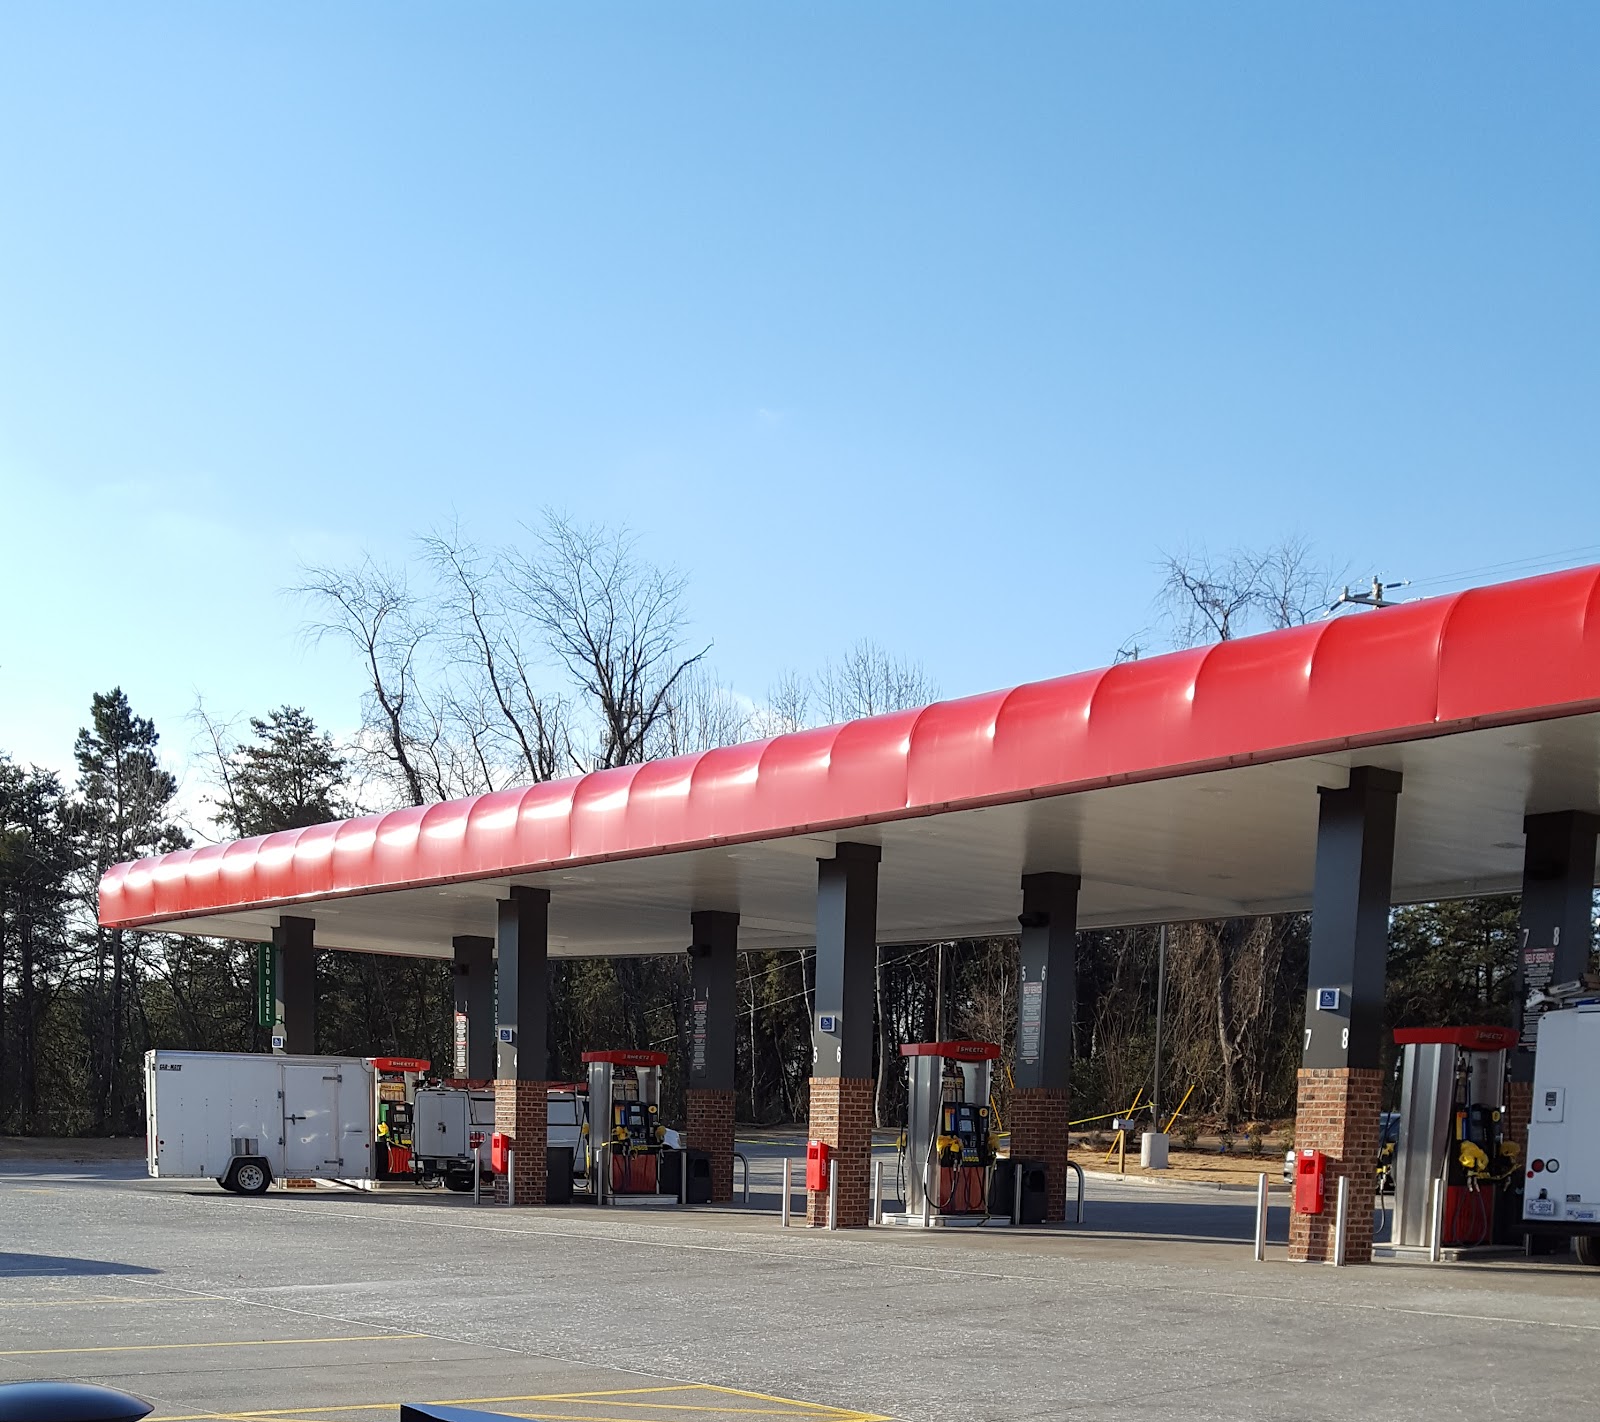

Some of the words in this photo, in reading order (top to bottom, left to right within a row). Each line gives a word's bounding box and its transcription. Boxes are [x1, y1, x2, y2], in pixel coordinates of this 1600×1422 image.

[1523, 929, 1530, 948] 7
[1553, 927, 1560, 946] 8
[1525, 954, 1535, 964] SELF
[1536, 952, 1554, 963] SERVICE
[1021, 966, 1026, 981] 5
[1041, 965, 1046, 980] 6
[1305, 1029, 1312, 1050] 7
[1342, 1028, 1349, 1049] 8
[836, 1046, 841, 1063] 6
